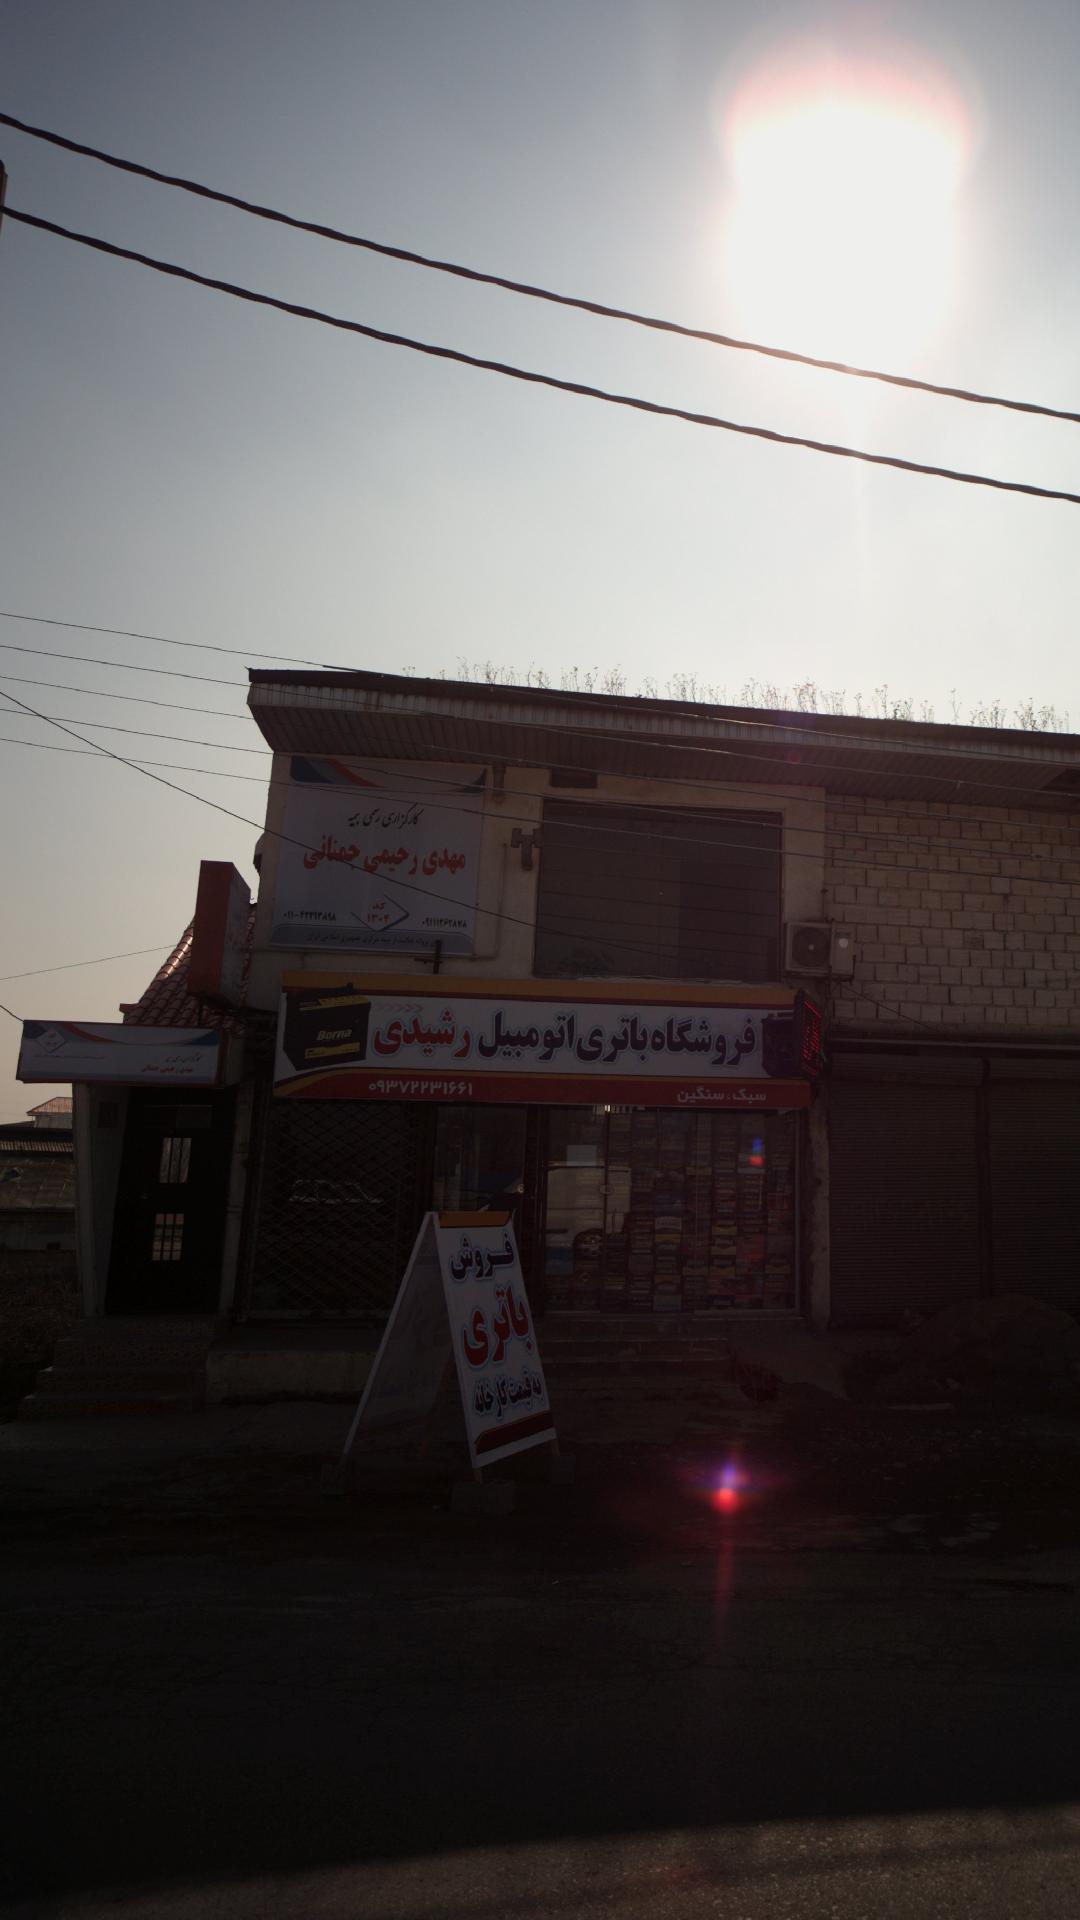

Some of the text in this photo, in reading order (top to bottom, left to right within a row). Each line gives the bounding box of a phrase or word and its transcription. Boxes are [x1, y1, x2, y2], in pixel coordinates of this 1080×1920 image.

[364, 847, 418, 875] رحیمی
[422, 847, 466, 875] مهدی
[373, 1010, 472, 1058] رشیدی
[478, 1010, 576, 1061] اتومبیل
[576, 1014, 649, 1063] باتری
[650, 1015, 757, 1067] فروشگاه
[367, 1079, 473, 1096] ۰۹۳۷۲۲۳۱۶۶۱
[676, 1085, 725, 1103] سنگین
[450, 1232, 515, 1279] فروش
[463, 1284, 534, 1366] باتری
[508, 1370, 533, 1406] قیمت
[532, 1375, 545, 1401] به
